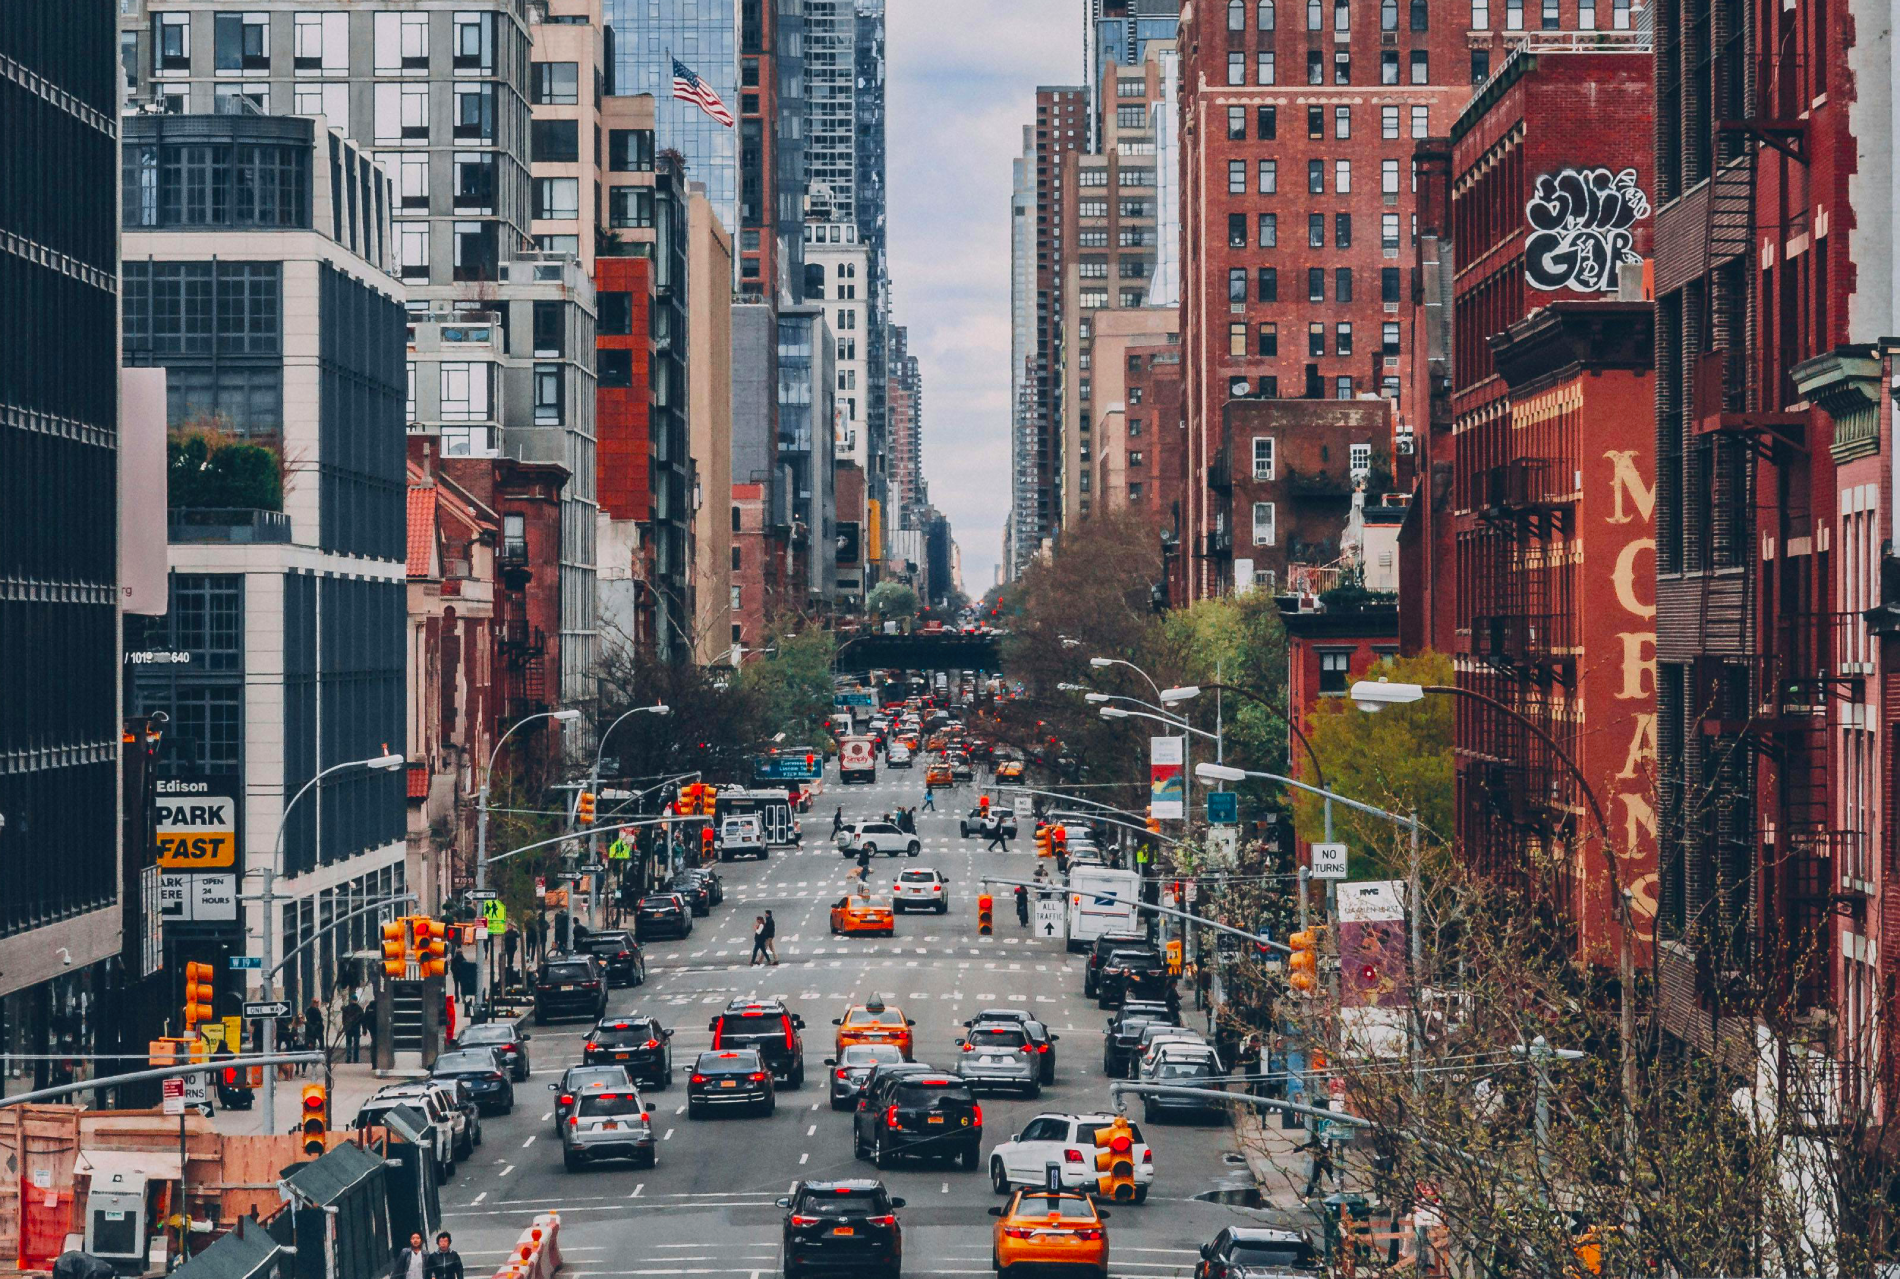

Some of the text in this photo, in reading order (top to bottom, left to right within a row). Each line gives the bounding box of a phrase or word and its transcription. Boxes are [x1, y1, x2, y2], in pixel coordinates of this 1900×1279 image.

[156, 780, 208, 793] Edison
[156, 805, 227, 826] PARK
[156, 838, 226, 860] FAST
[1322, 849, 1337, 860] NO
[1315, 863, 1345, 873] TURNS
[202, 887, 212, 895] 24
[201, 897, 230, 905] HOURS
[1042, 903, 1056, 911] ALL
[1036, 912, 1062, 921] TRAFFIC
[242, 958, 251, 967] 19
[250, 1004, 284, 1014] ONE WAY
